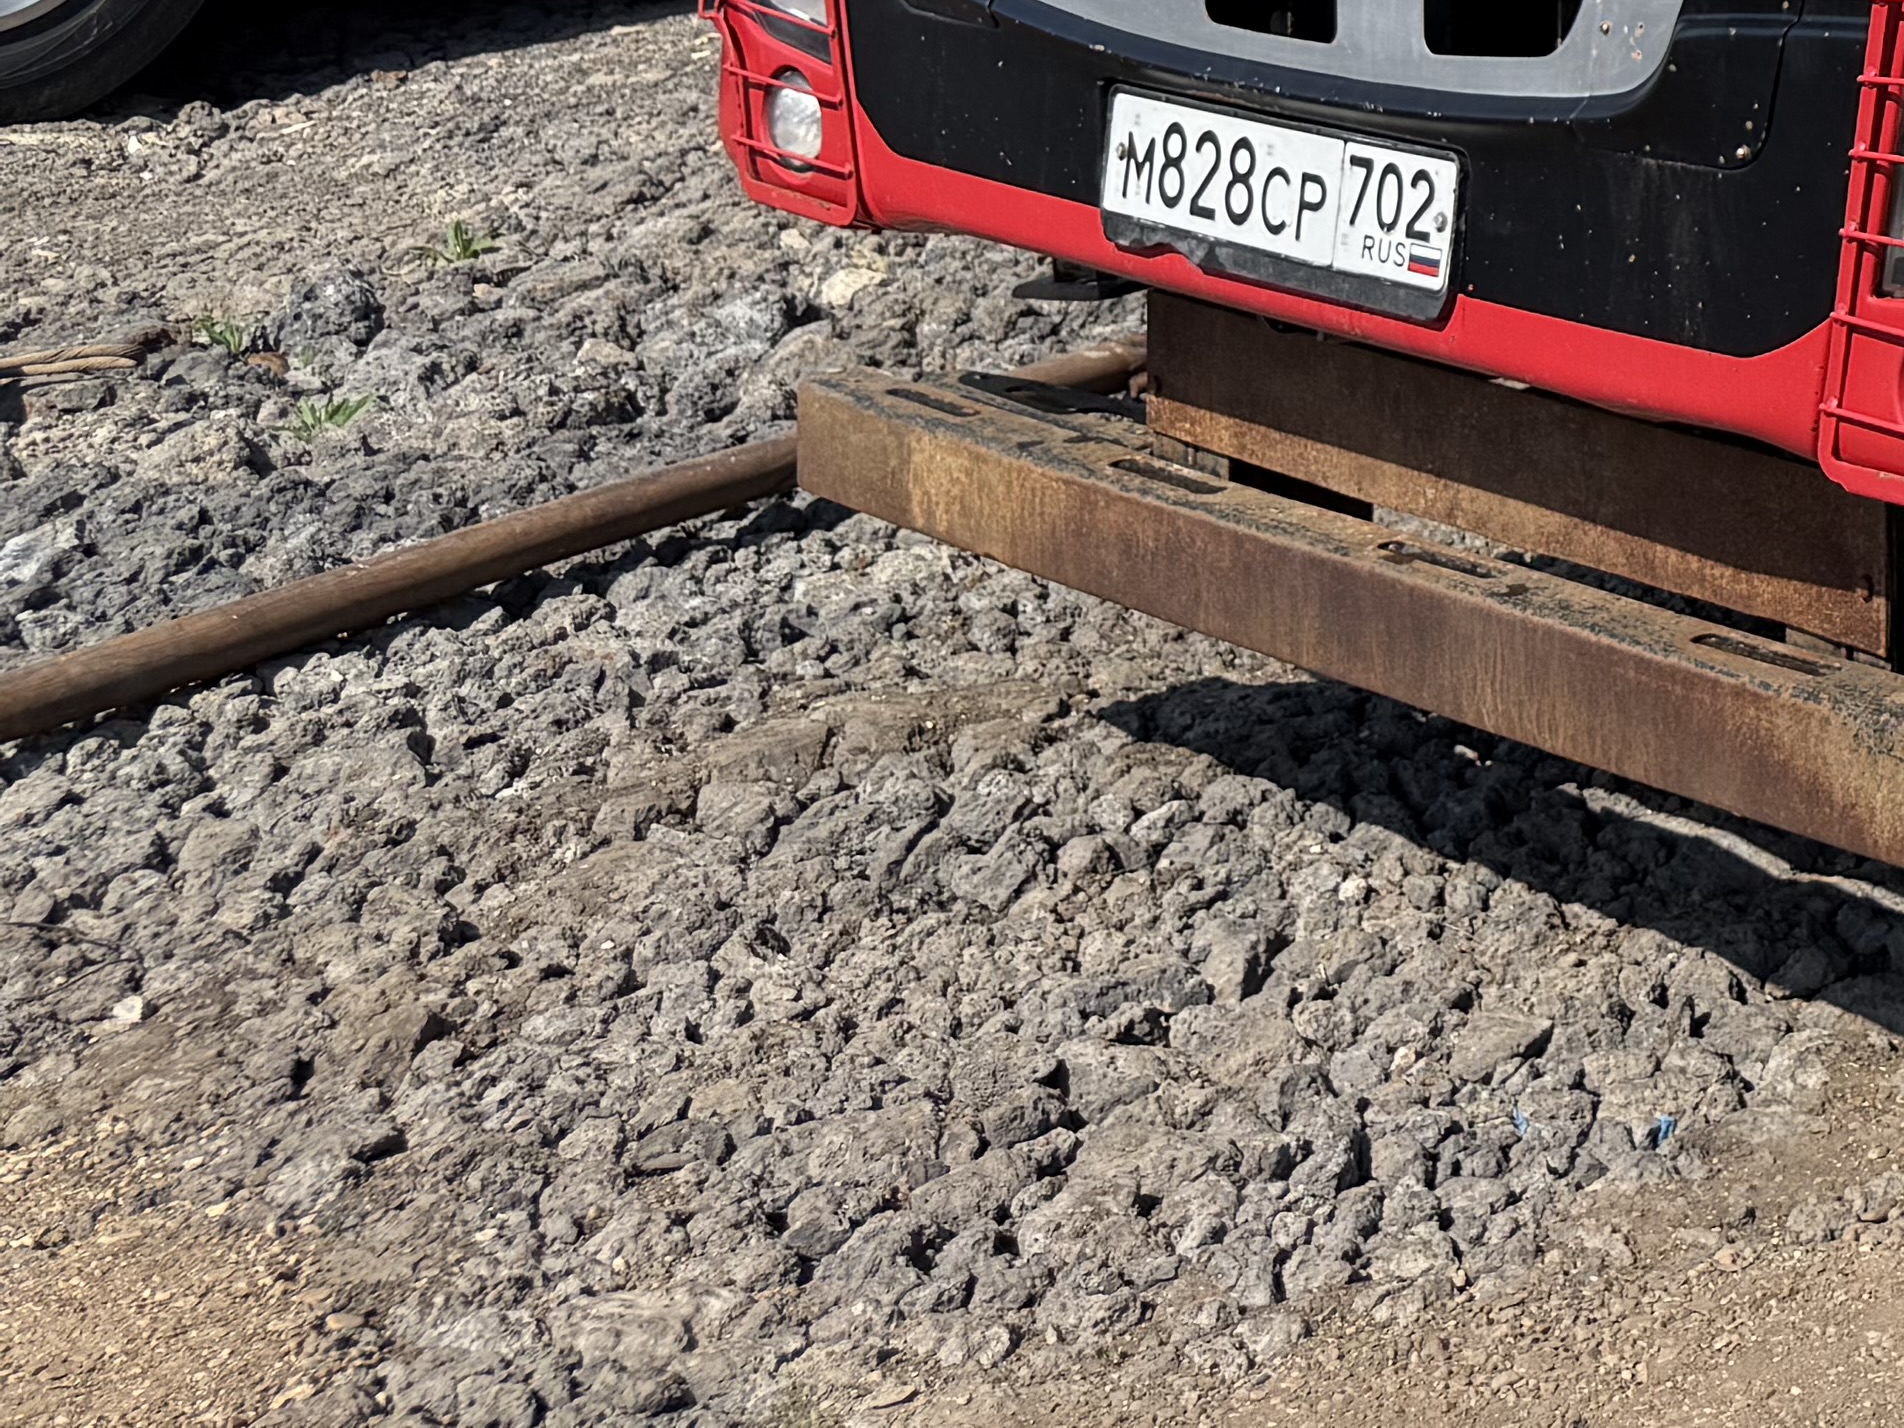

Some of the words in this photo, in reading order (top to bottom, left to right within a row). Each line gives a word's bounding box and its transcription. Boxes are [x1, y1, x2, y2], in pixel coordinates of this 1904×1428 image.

[1122, 121, 1327, 242] М828СР
[1349, 154, 1435, 242] 702
[1361, 234, 1406, 267] RUS
